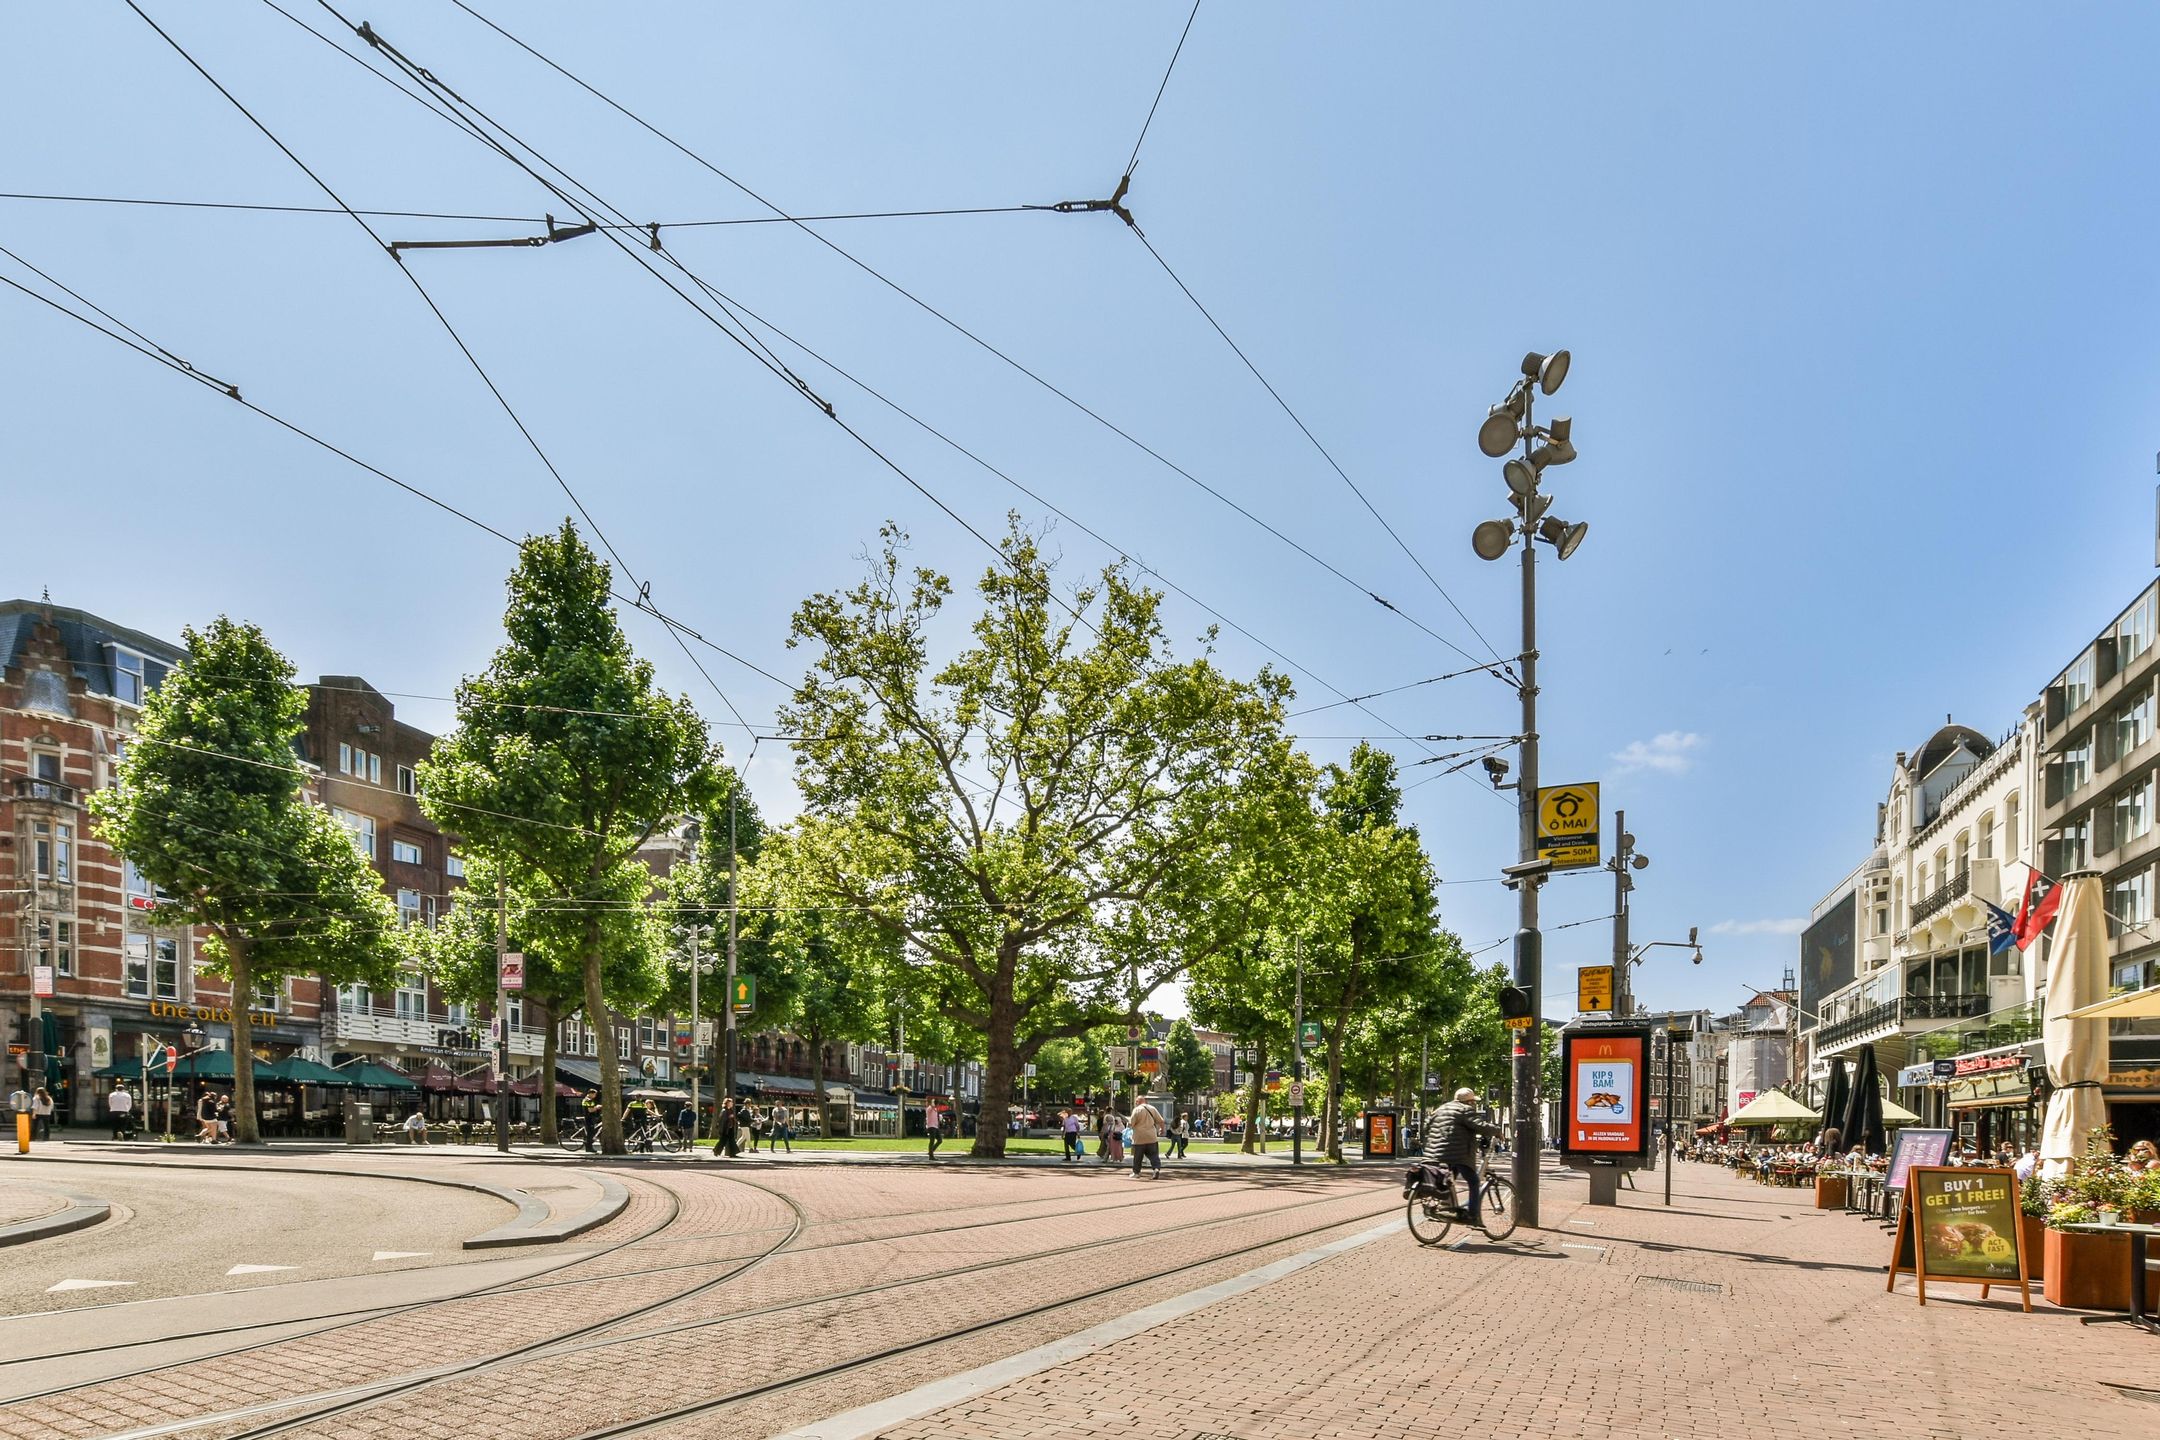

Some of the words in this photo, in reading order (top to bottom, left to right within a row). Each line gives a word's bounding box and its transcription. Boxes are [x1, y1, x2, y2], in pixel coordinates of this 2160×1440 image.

[1563, 819, 1587, 829] MAI
[1572, 848, 1592, 856] 50M
[149, 1000, 190, 1019] the
[197, 1006, 234, 1022] old
[1506, 1018, 1531, 1027] 268-V
[438, 1026, 480, 1049] rain
[1592, 1070, 1606, 1080] KIP
[1608, 1070, 1613, 1080] 9
[2107, 1074, 2142, 1083] Three
[1593, 1079, 1614, 1088] BAM!
[1944, 1180, 1972, 1192] BUY
[1975, 1178, 1984, 1189] 1
[1926, 1195, 1951, 1206] GET
[1955, 1193, 1962, 1203] 1
[1968, 1190, 2005, 1202] FREE!
[1987, 1245, 2004, 1253] FAST
